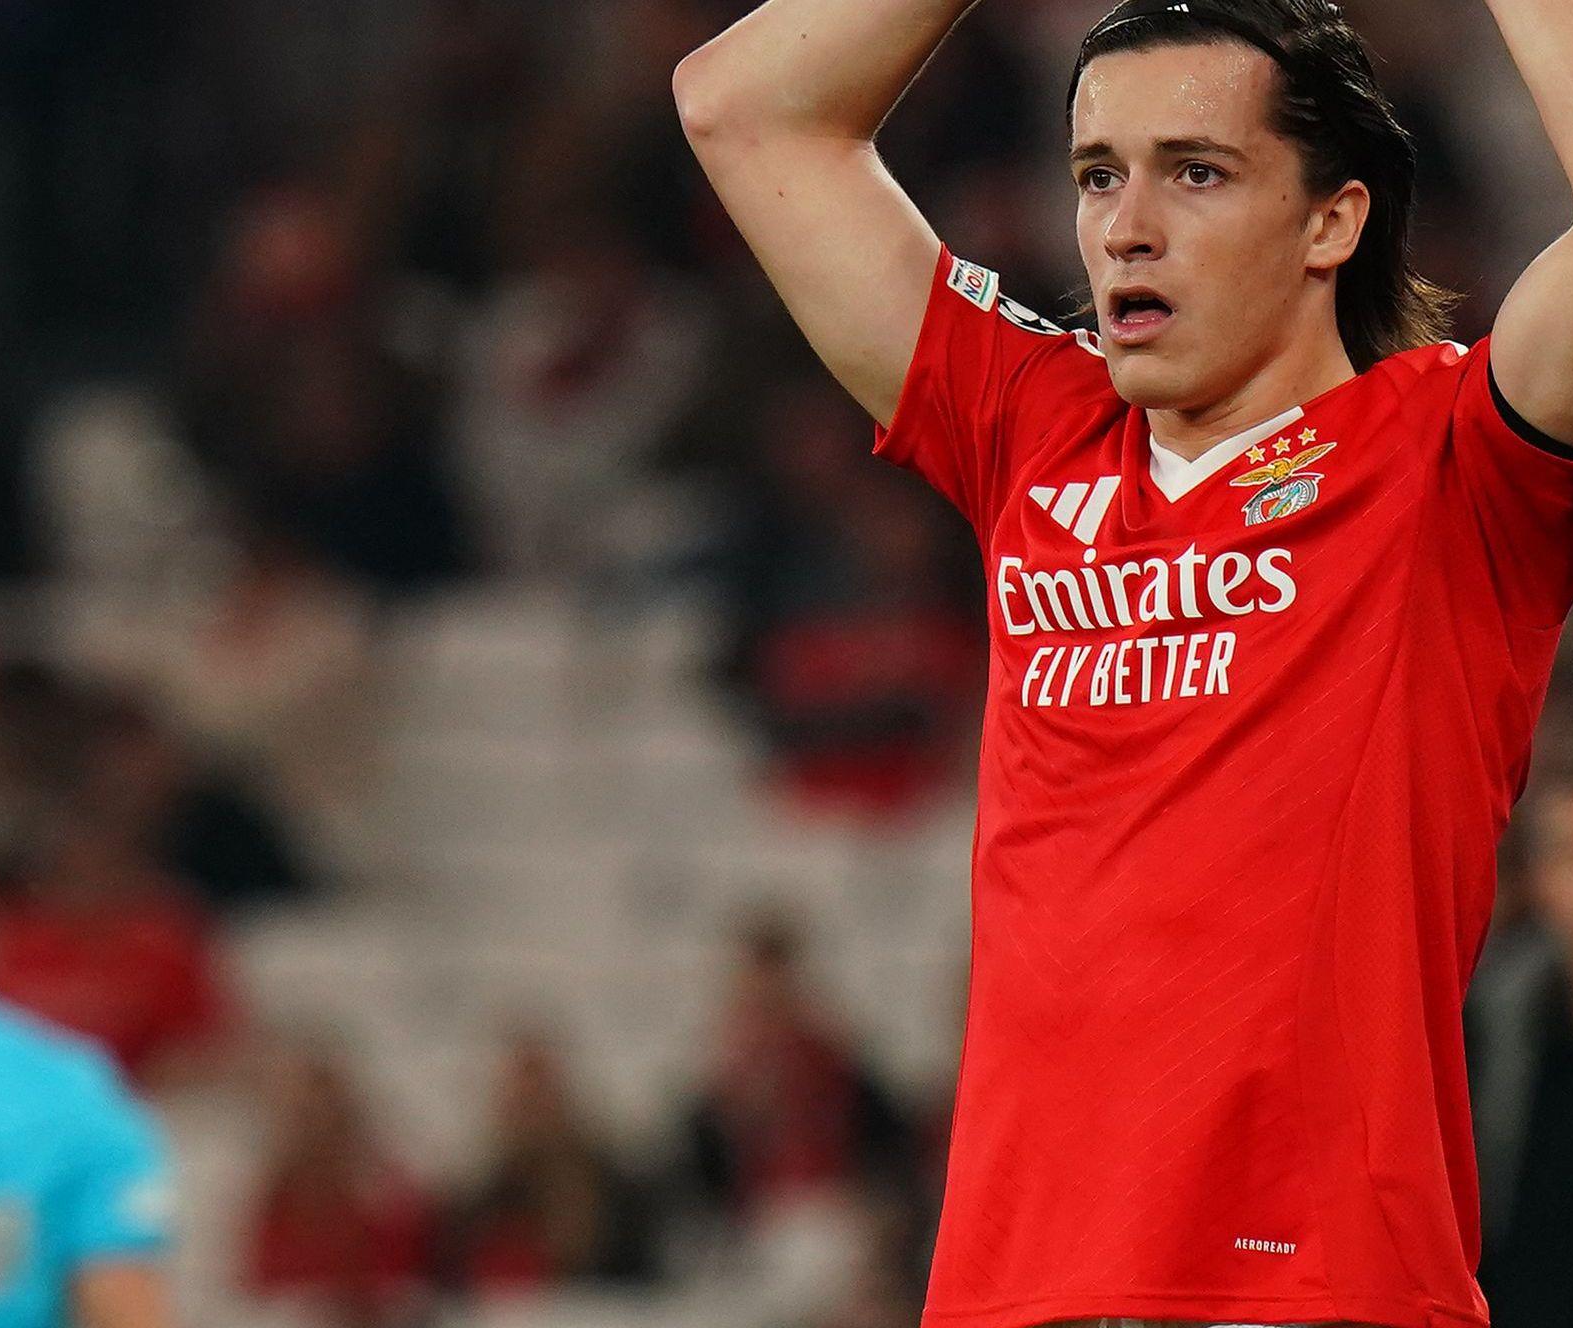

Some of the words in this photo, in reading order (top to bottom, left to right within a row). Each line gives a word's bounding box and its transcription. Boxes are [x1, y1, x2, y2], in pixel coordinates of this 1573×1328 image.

[997, 542, 1297, 636] Emirates
[1021, 645, 1091, 707] FLY
[1089, 631, 1237, 706] BETTER
[1234, 1237, 1297, 1255] AEROREADY
